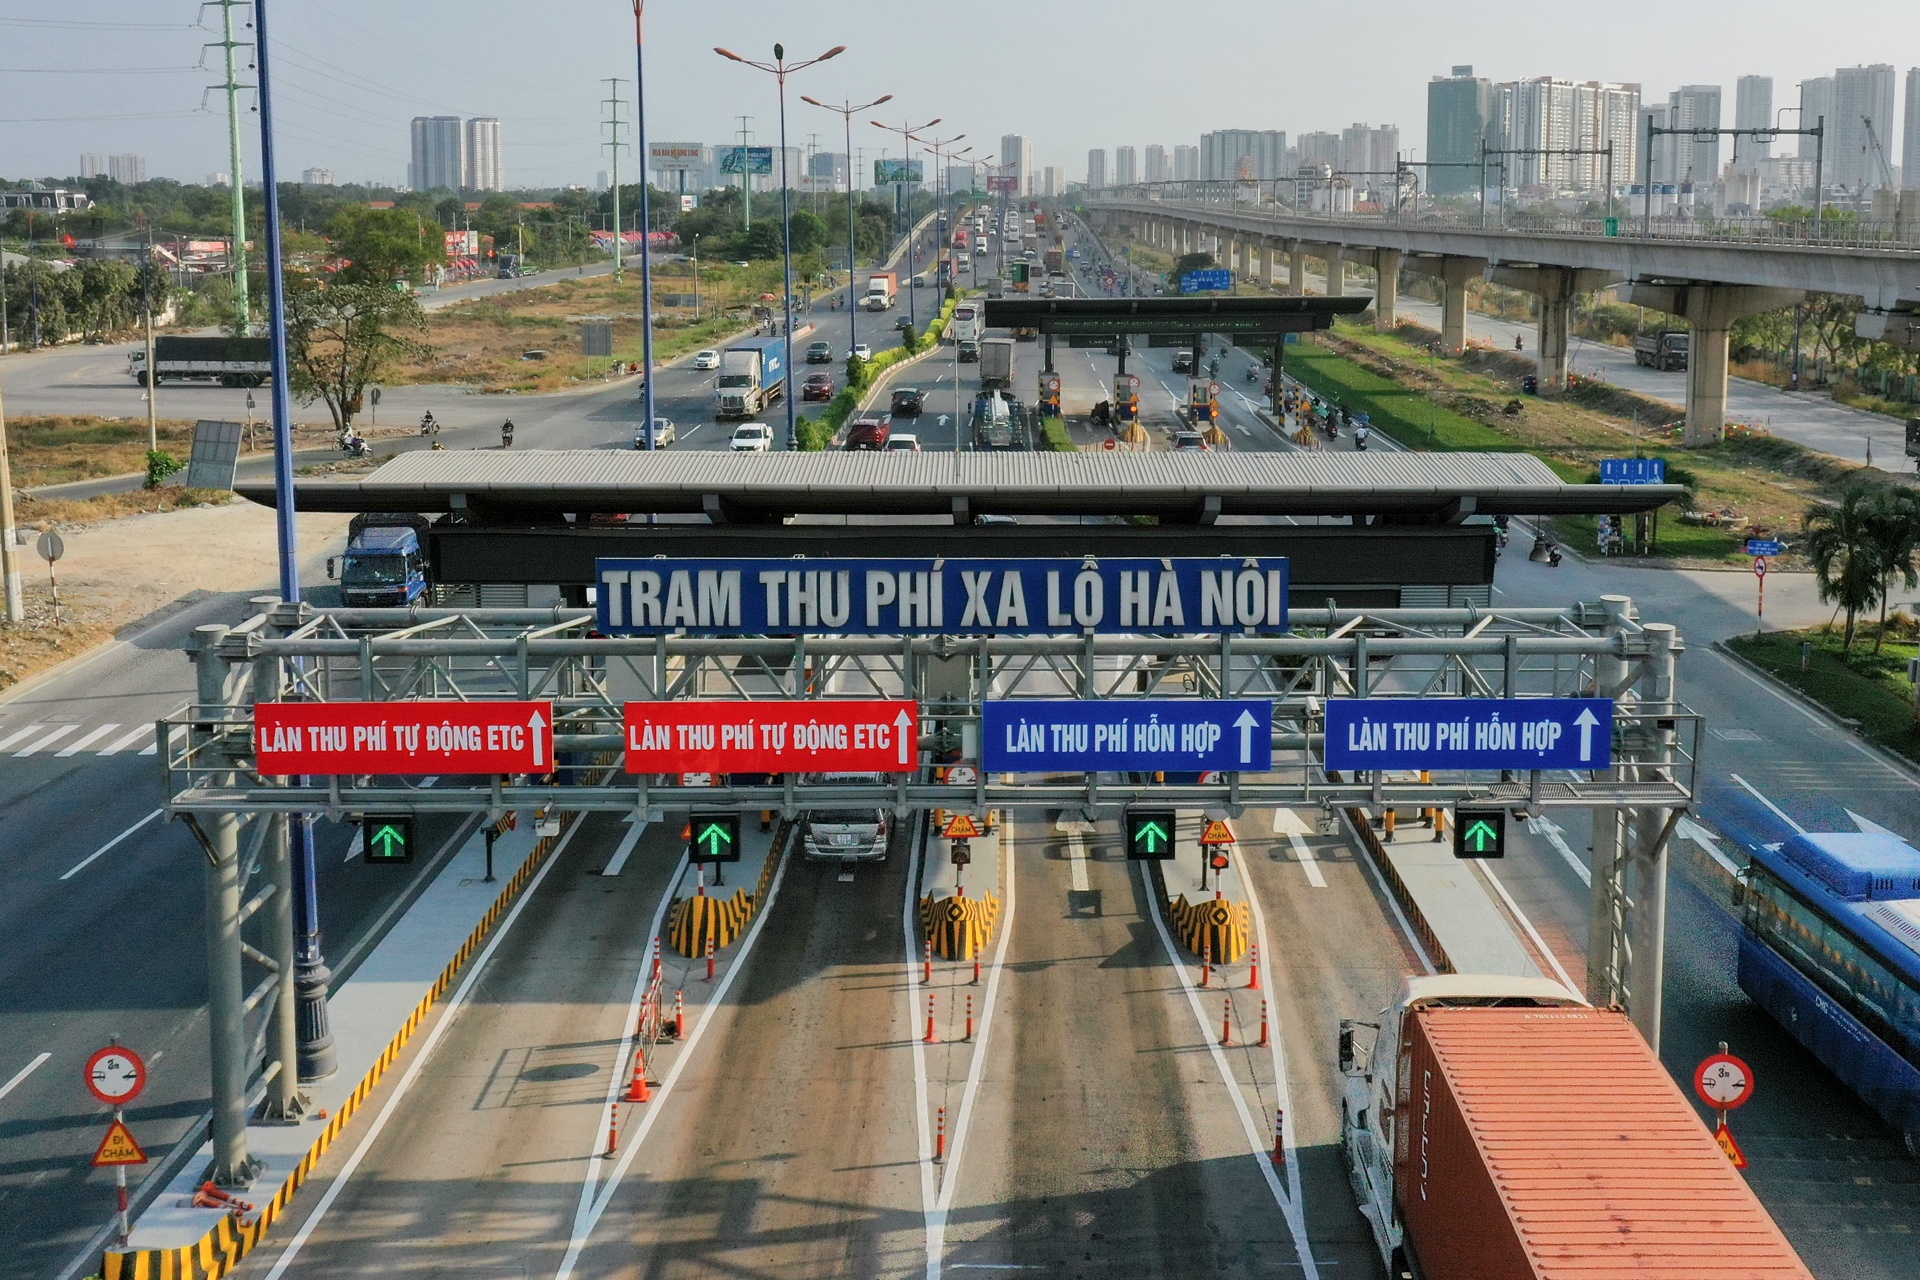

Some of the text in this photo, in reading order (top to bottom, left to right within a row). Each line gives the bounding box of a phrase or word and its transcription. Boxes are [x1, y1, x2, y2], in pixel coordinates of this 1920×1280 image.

[602, 558, 1280, 635] TRẠM THU PHÍ XA LỘ HÀ NỘI
[261, 720, 524, 757] LÀN THU PHÍ TỰ ĐỘNG ETC
[629, 718, 890, 755] LÀN THU PHÍ TỰ ĐỘNG ETC
[1006, 714, 1221, 758] LÀN THU PHÍ HỖN HỢP
[1349, 712, 1562, 757] LÀN THU PHÍ HỖN HỢP
[1718, 1068, 1729, 1078] 3m
[112, 1136, 123, 1145] ĐI
